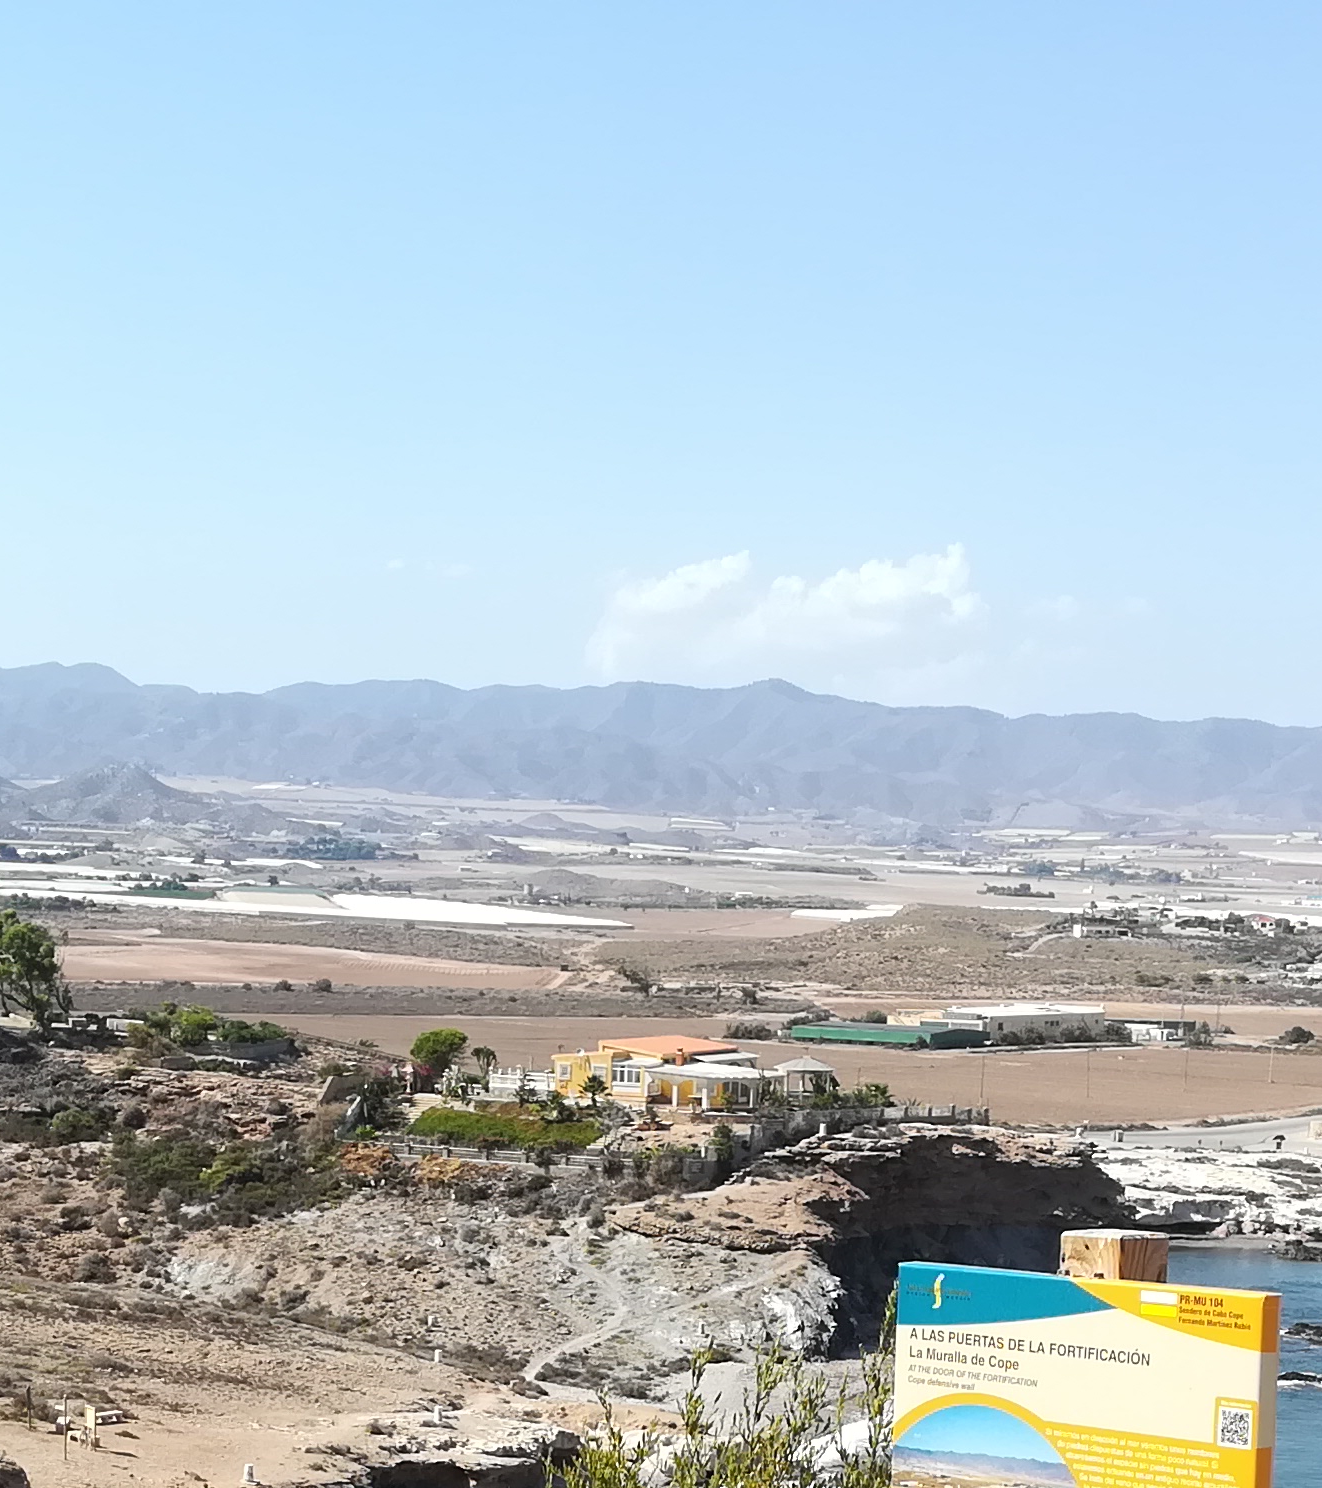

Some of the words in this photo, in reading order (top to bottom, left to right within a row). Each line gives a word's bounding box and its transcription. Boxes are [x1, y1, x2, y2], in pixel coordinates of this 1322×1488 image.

[1179, 1294, 1207, 1306] PR-MU
[1208, 1297, 1224, 1308] 104
[909, 1327, 918, 1339] A
[921, 1328, 945, 1342] LAS
[948, 1331, 1004, 1349] PUERTAS
[1008, 1338, 1025, 1351] DE
[1029, 1340, 1045, 1354] LA
[1049, 1342, 1151, 1366] FORTIFICACIÓN
[909, 1345, 923, 1359] La
[926, 1347, 967, 1364] Muralla
[971, 1353, 985, 1366] de
[988, 1355, 1019, 1373] Cope
[907, 1375, 925, 1385] Cope
[908, 1364, 916, 1372] AT
[917, 1365, 931, 1374] THE
[956, 1370, 966, 1379] OF
[967, 1371, 981, 1380] THE
[982, 1373, 1038, 1387] FORTIFICATION
